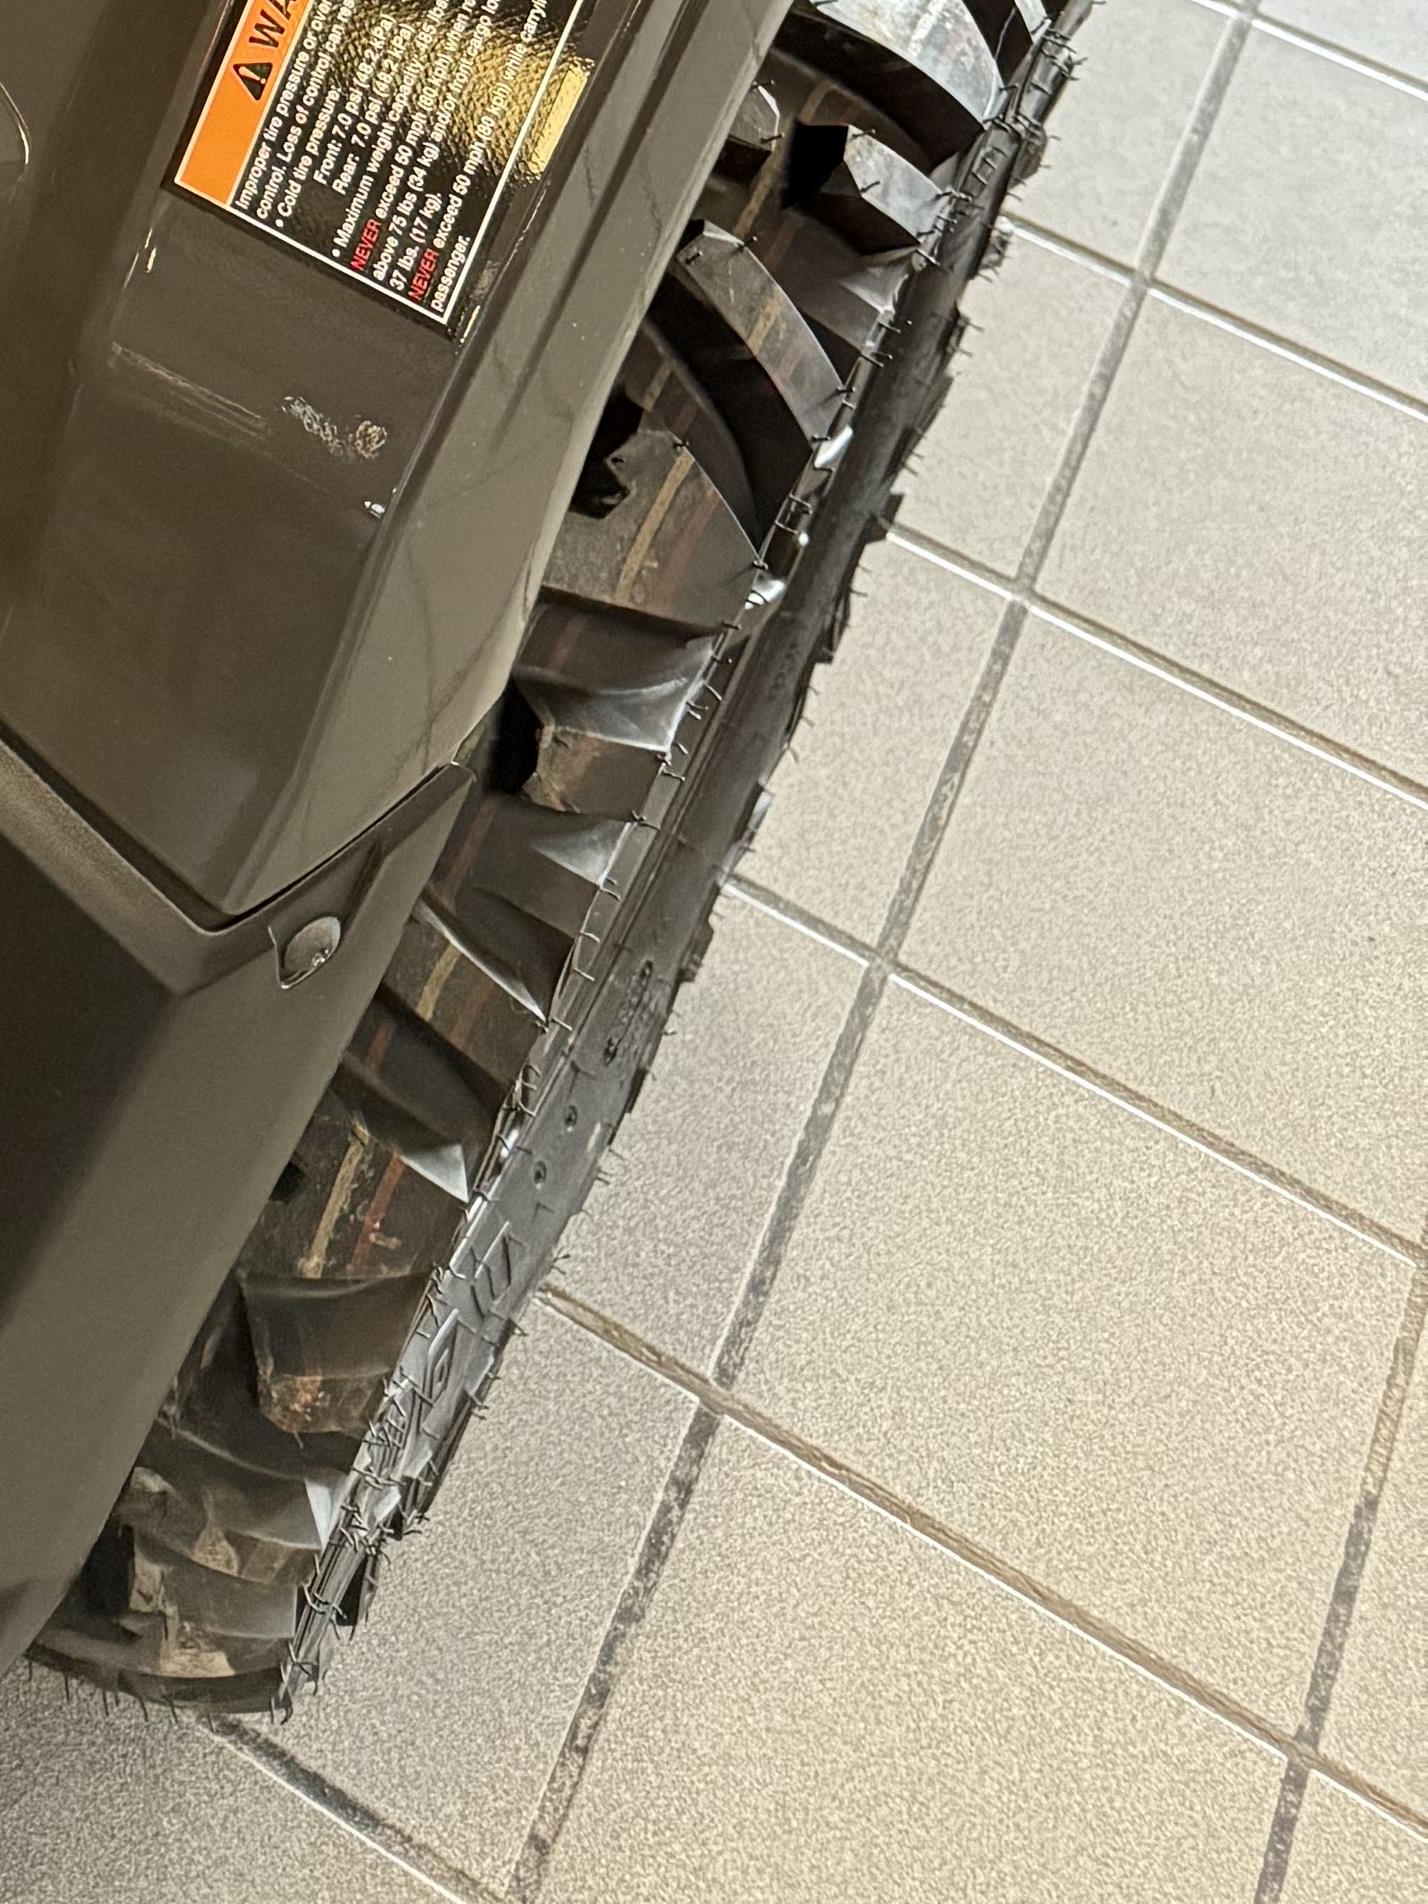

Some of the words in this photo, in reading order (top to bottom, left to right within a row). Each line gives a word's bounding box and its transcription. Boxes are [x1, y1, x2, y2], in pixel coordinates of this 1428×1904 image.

[322, 22, 345, 53] can
[369, 11, 396, 50] kPa)
[442, 11, 470, 53] when
[464, 13, 495, 59] cargo
[299, 51, 333, 107] control
[353, 48, 381, 88] (48.2
[500, 41, 526, 81] while
[292, 104, 311, 125] of
[342, 86, 365, 114] psi
[417, 85, 439, 112] (80
[427, 92, 459, 142] and/or
[235, 141, 274, 210] Improper
[262, 114, 283, 142] tire
[274, 50, 313, 117] pressure
[302, 30, 318, 50] or
[331, 111, 353, 139] 7.0
[402, 110, 429, 147] mph
[475, 114, 497, 141] (80
[276, 122, 303, 163] Loss
[276, 179, 302, 218] Cold
[291, 152, 313, 181] tire
[304, 84, 344, 155] pressure:
[312, 137, 342, 185] Front:
[331, 150, 360, 195] Rear:
[350, 120, 372, 149] 7.0
[361, 95, 385, 124] psi
[394, 143, 413, 166] 50
[417, 139, 440, 168] kg)
[460, 138, 487, 176] mph
[252, 161, 287, 219] control.
[332, 172, 374, 248] Maximum
[363, 120, 398, 175] weight
[372, 164, 405, 219] exceed
[407, 165, 430, 192] (34
[452, 172, 471, 195] 50
[397, 189, 418, 215] lbs
[419, 187, 444, 219] kg).
[429, 193, 463, 250] exceed
[350, 217, 382, 271] NEVER
[388, 213, 408, 236] 75
[408, 216, 432, 244] (17
[369, 233, 399, 281] above
[397, 240, 420, 271] lbs.
[408, 247, 440, 301] NEVER
[429, 232, 473, 312] passenger.
[388, 268, 408, 291] 37
